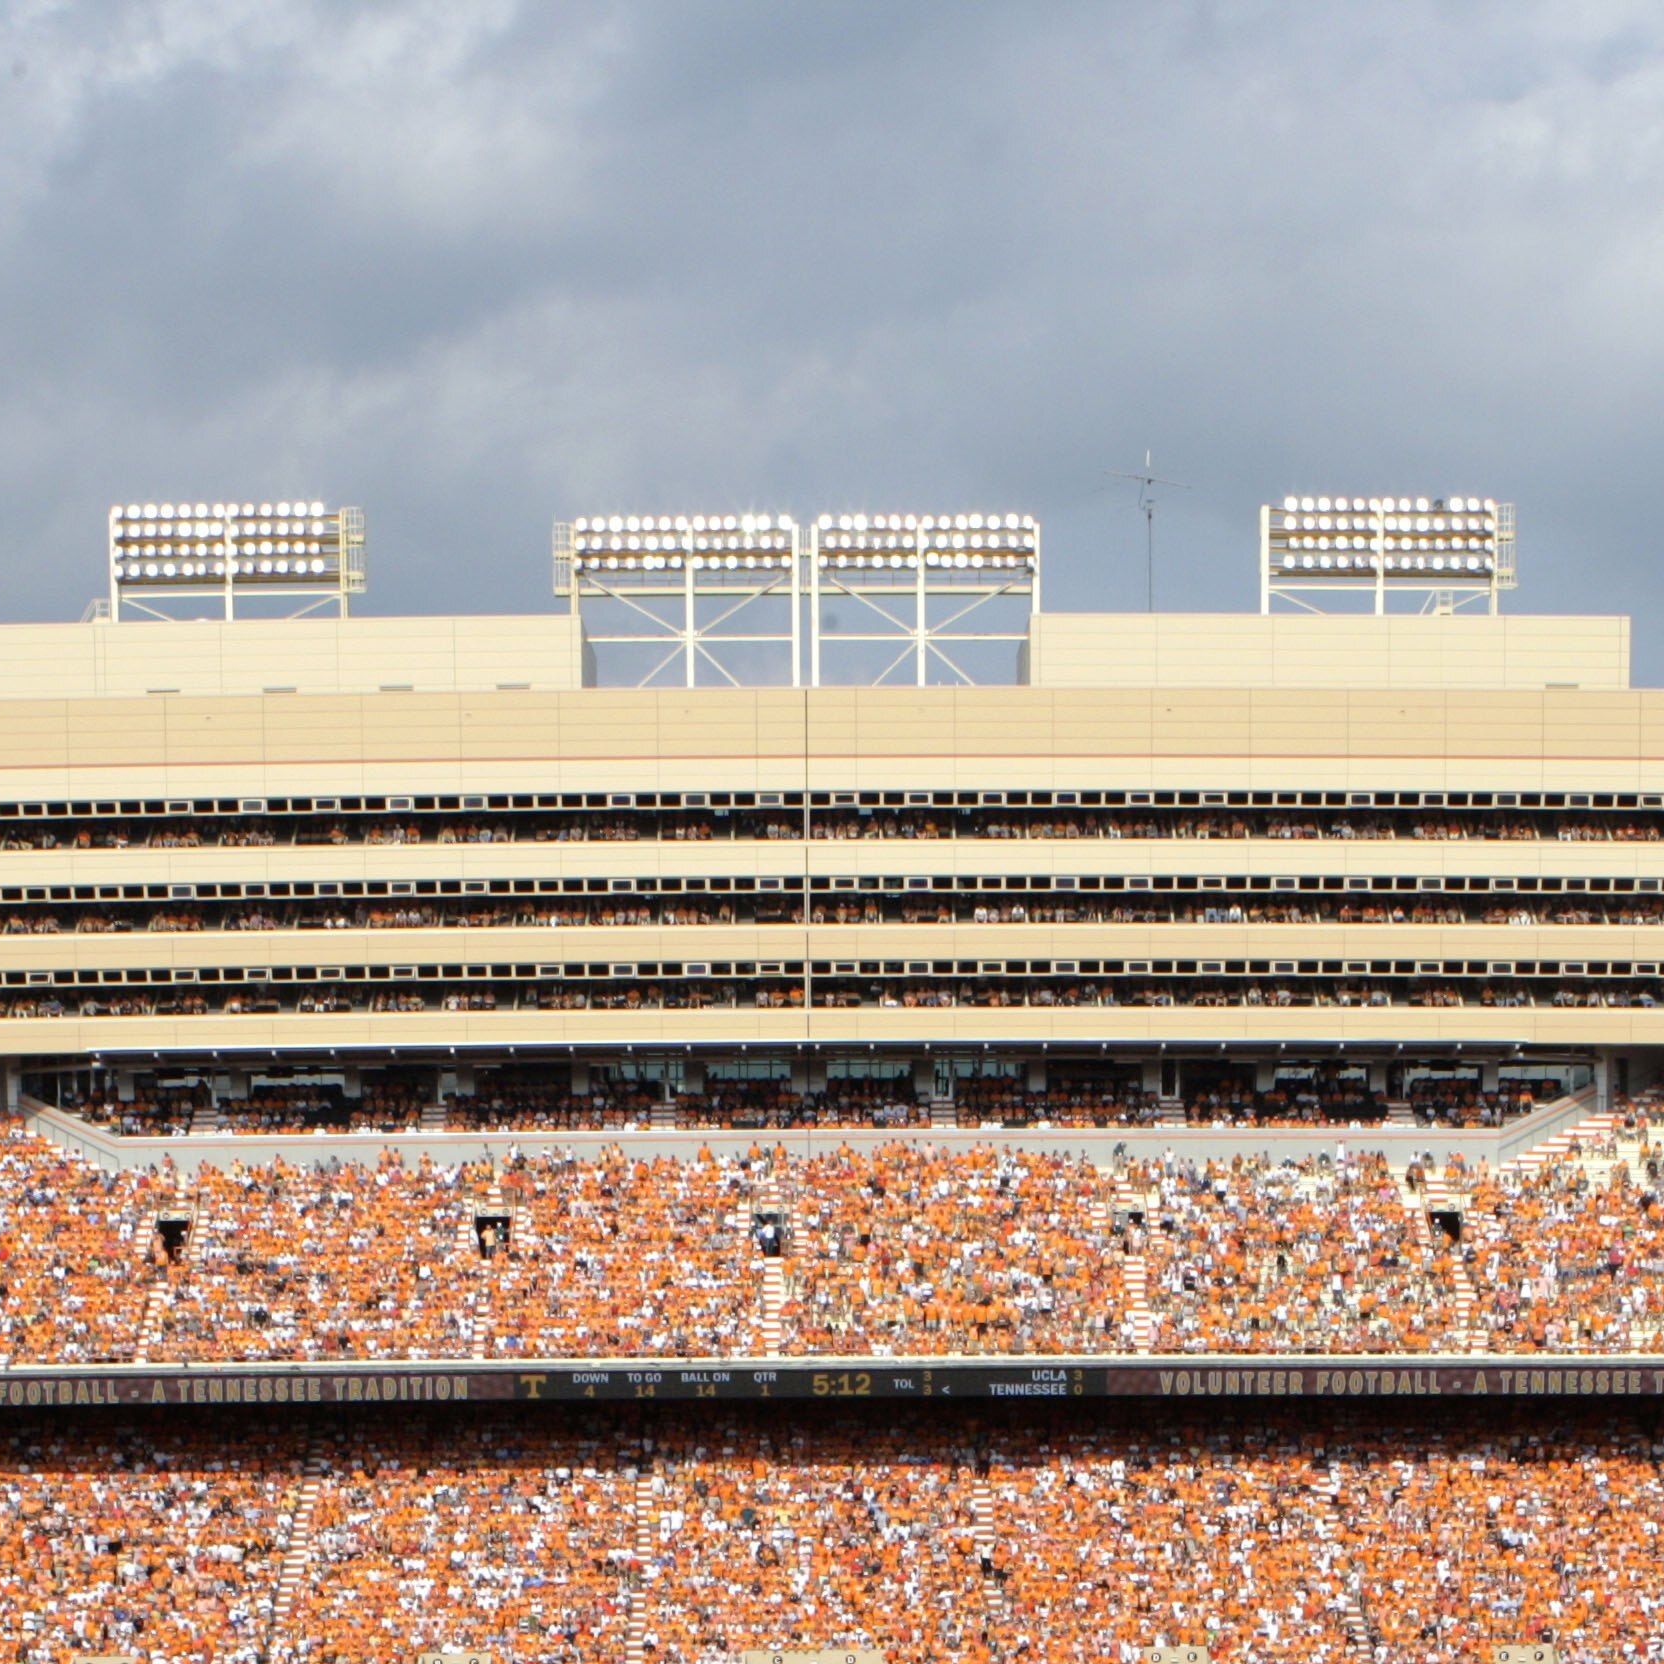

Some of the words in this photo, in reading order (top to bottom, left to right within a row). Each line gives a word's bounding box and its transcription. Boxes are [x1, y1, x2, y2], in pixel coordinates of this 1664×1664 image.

[572, 1373, 609, 1384] DOWN
[626, 1373, 643, 1384] TO
[645, 1373, 662, 1384] GO
[681, 1372, 711, 1383] BALL
[713, 1372, 730, 1383] ON
[754, 1372, 777, 1383] QTR
[893, 1379, 914, 1390] TOL
[922, 1370, 933, 1382] 3
[1032, 1370, 1067, 1381] UCLA
[1074, 1370, 1084, 1382] 3
[813, 1373, 872, 1396] 5:12
[1159, 1371, 1303, 1395] VOLUNTEER
[1316, 1371, 1441, 1395] FOOTBALL
[1473, 1371, 1488, 1395] A
[1500, 1370, 1641, 1395] TENNESSEE
[151, 1379, 167, 1403] A
[177, 1377, 321, 1402] TENNESSEE
[333, 1376, 468, 1401] TRADITION
[584, 1385, 596, 1398] 4
[634, 1385, 655, 1398] 14
[696, 1385, 716, 1398] 14
[760, 1385, 771, 1397] 1
[922, 1384, 933, 1396] 3
[989, 1384, 1067, 1396] TENNESSEE
[1074, 1384, 1084, 1396] 0
